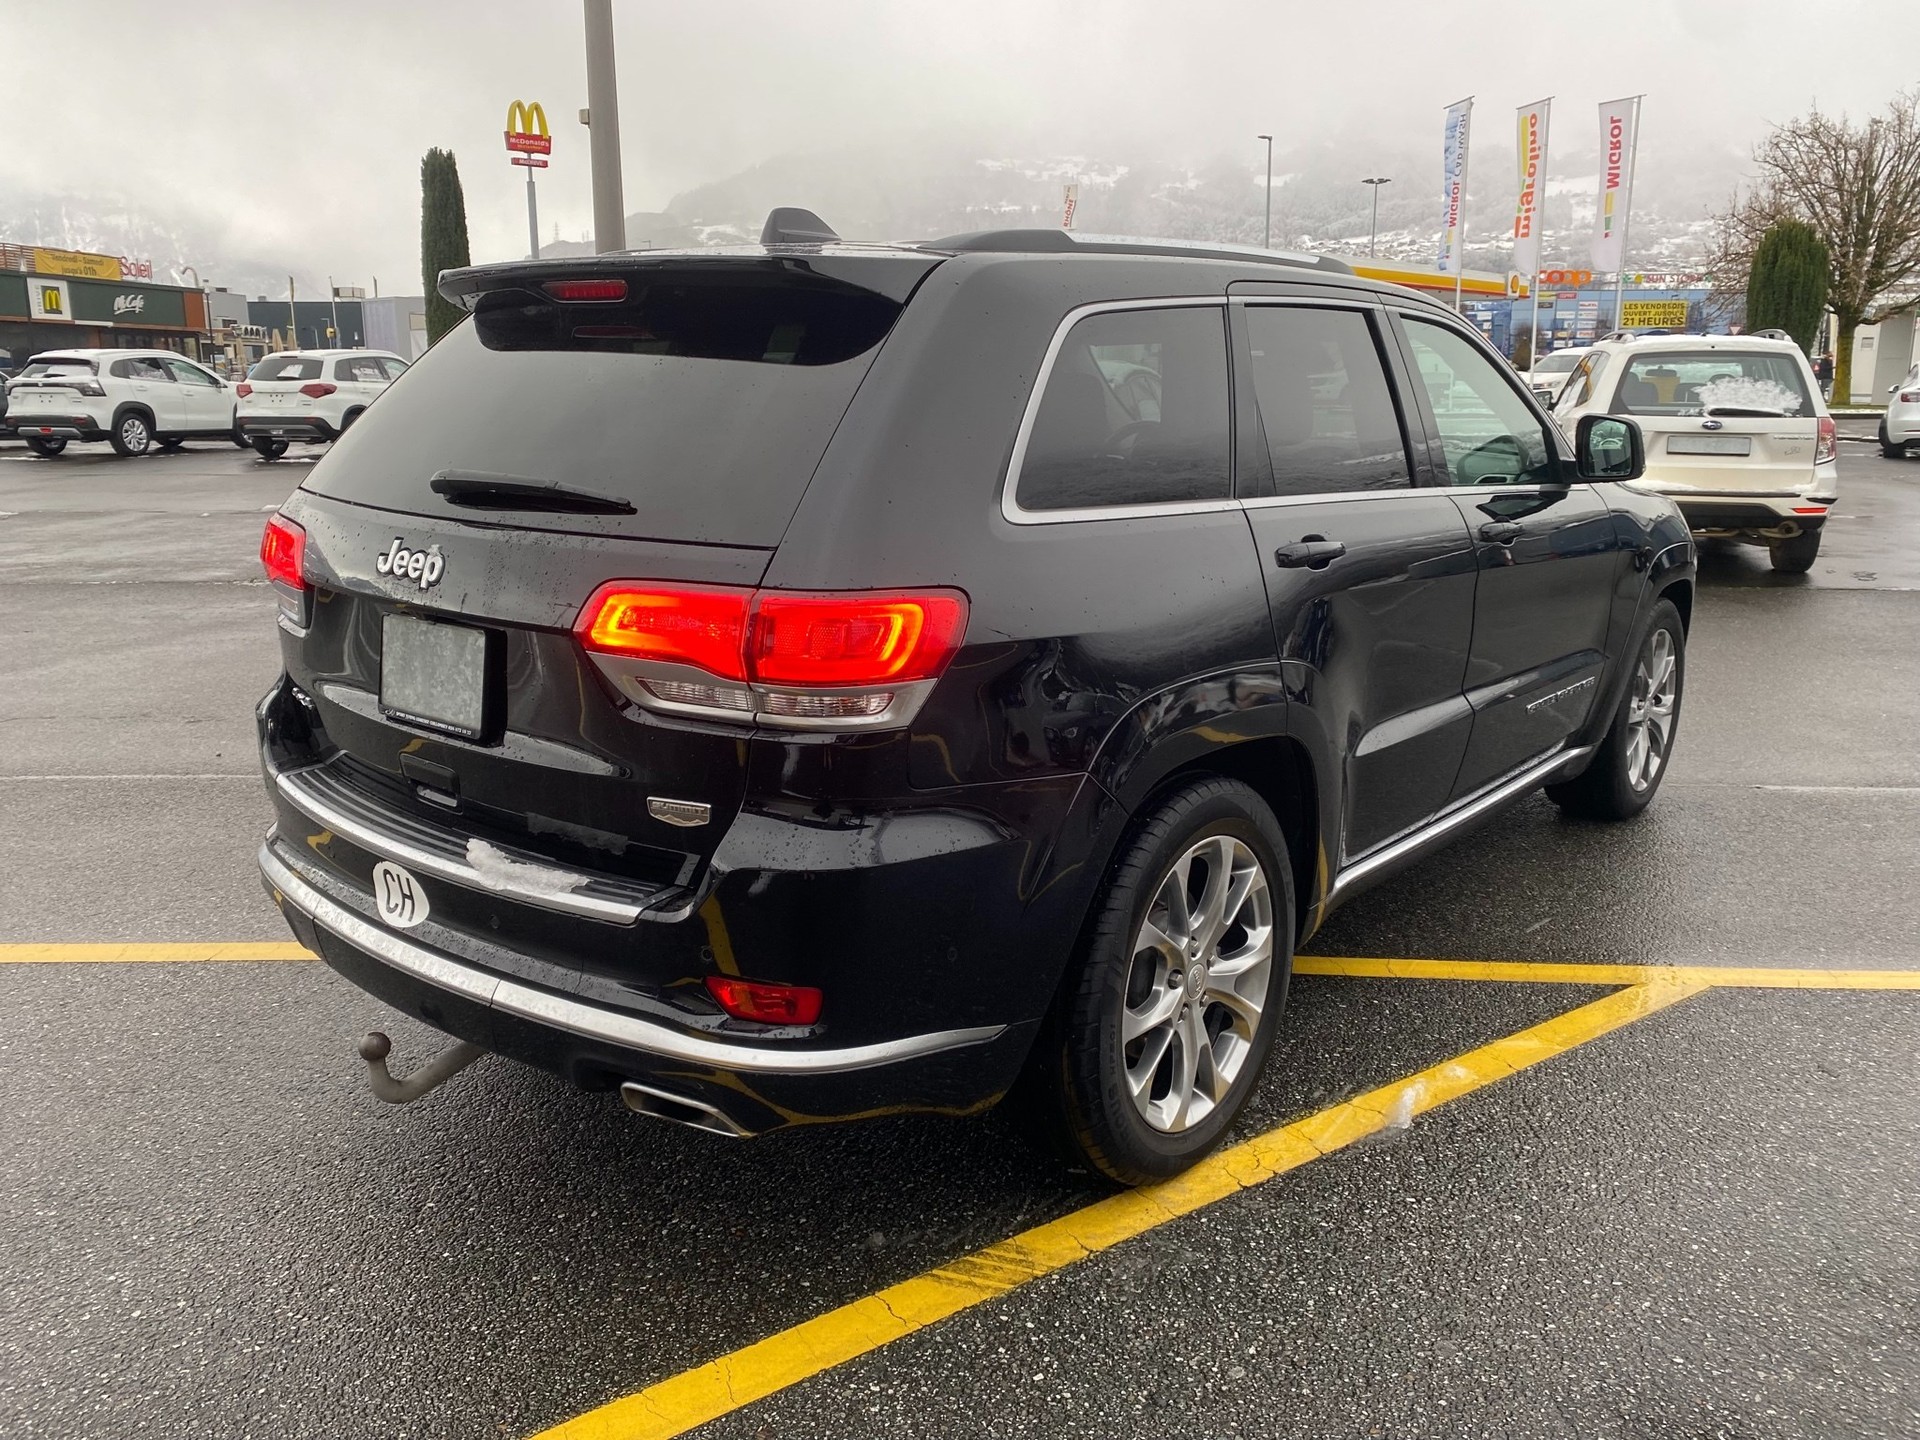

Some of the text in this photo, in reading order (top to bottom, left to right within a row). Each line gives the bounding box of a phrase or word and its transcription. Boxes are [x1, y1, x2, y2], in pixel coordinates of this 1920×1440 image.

[509, 137, 549, 146] McDonald's
[83, 265, 97, 276] 01h
[120, 256, 152, 278] Soleil
[1623, 317, 1684, 326] 21 HEURES
[377, 536, 444, 590] Jeep
[383, 868, 416, 922] CH
